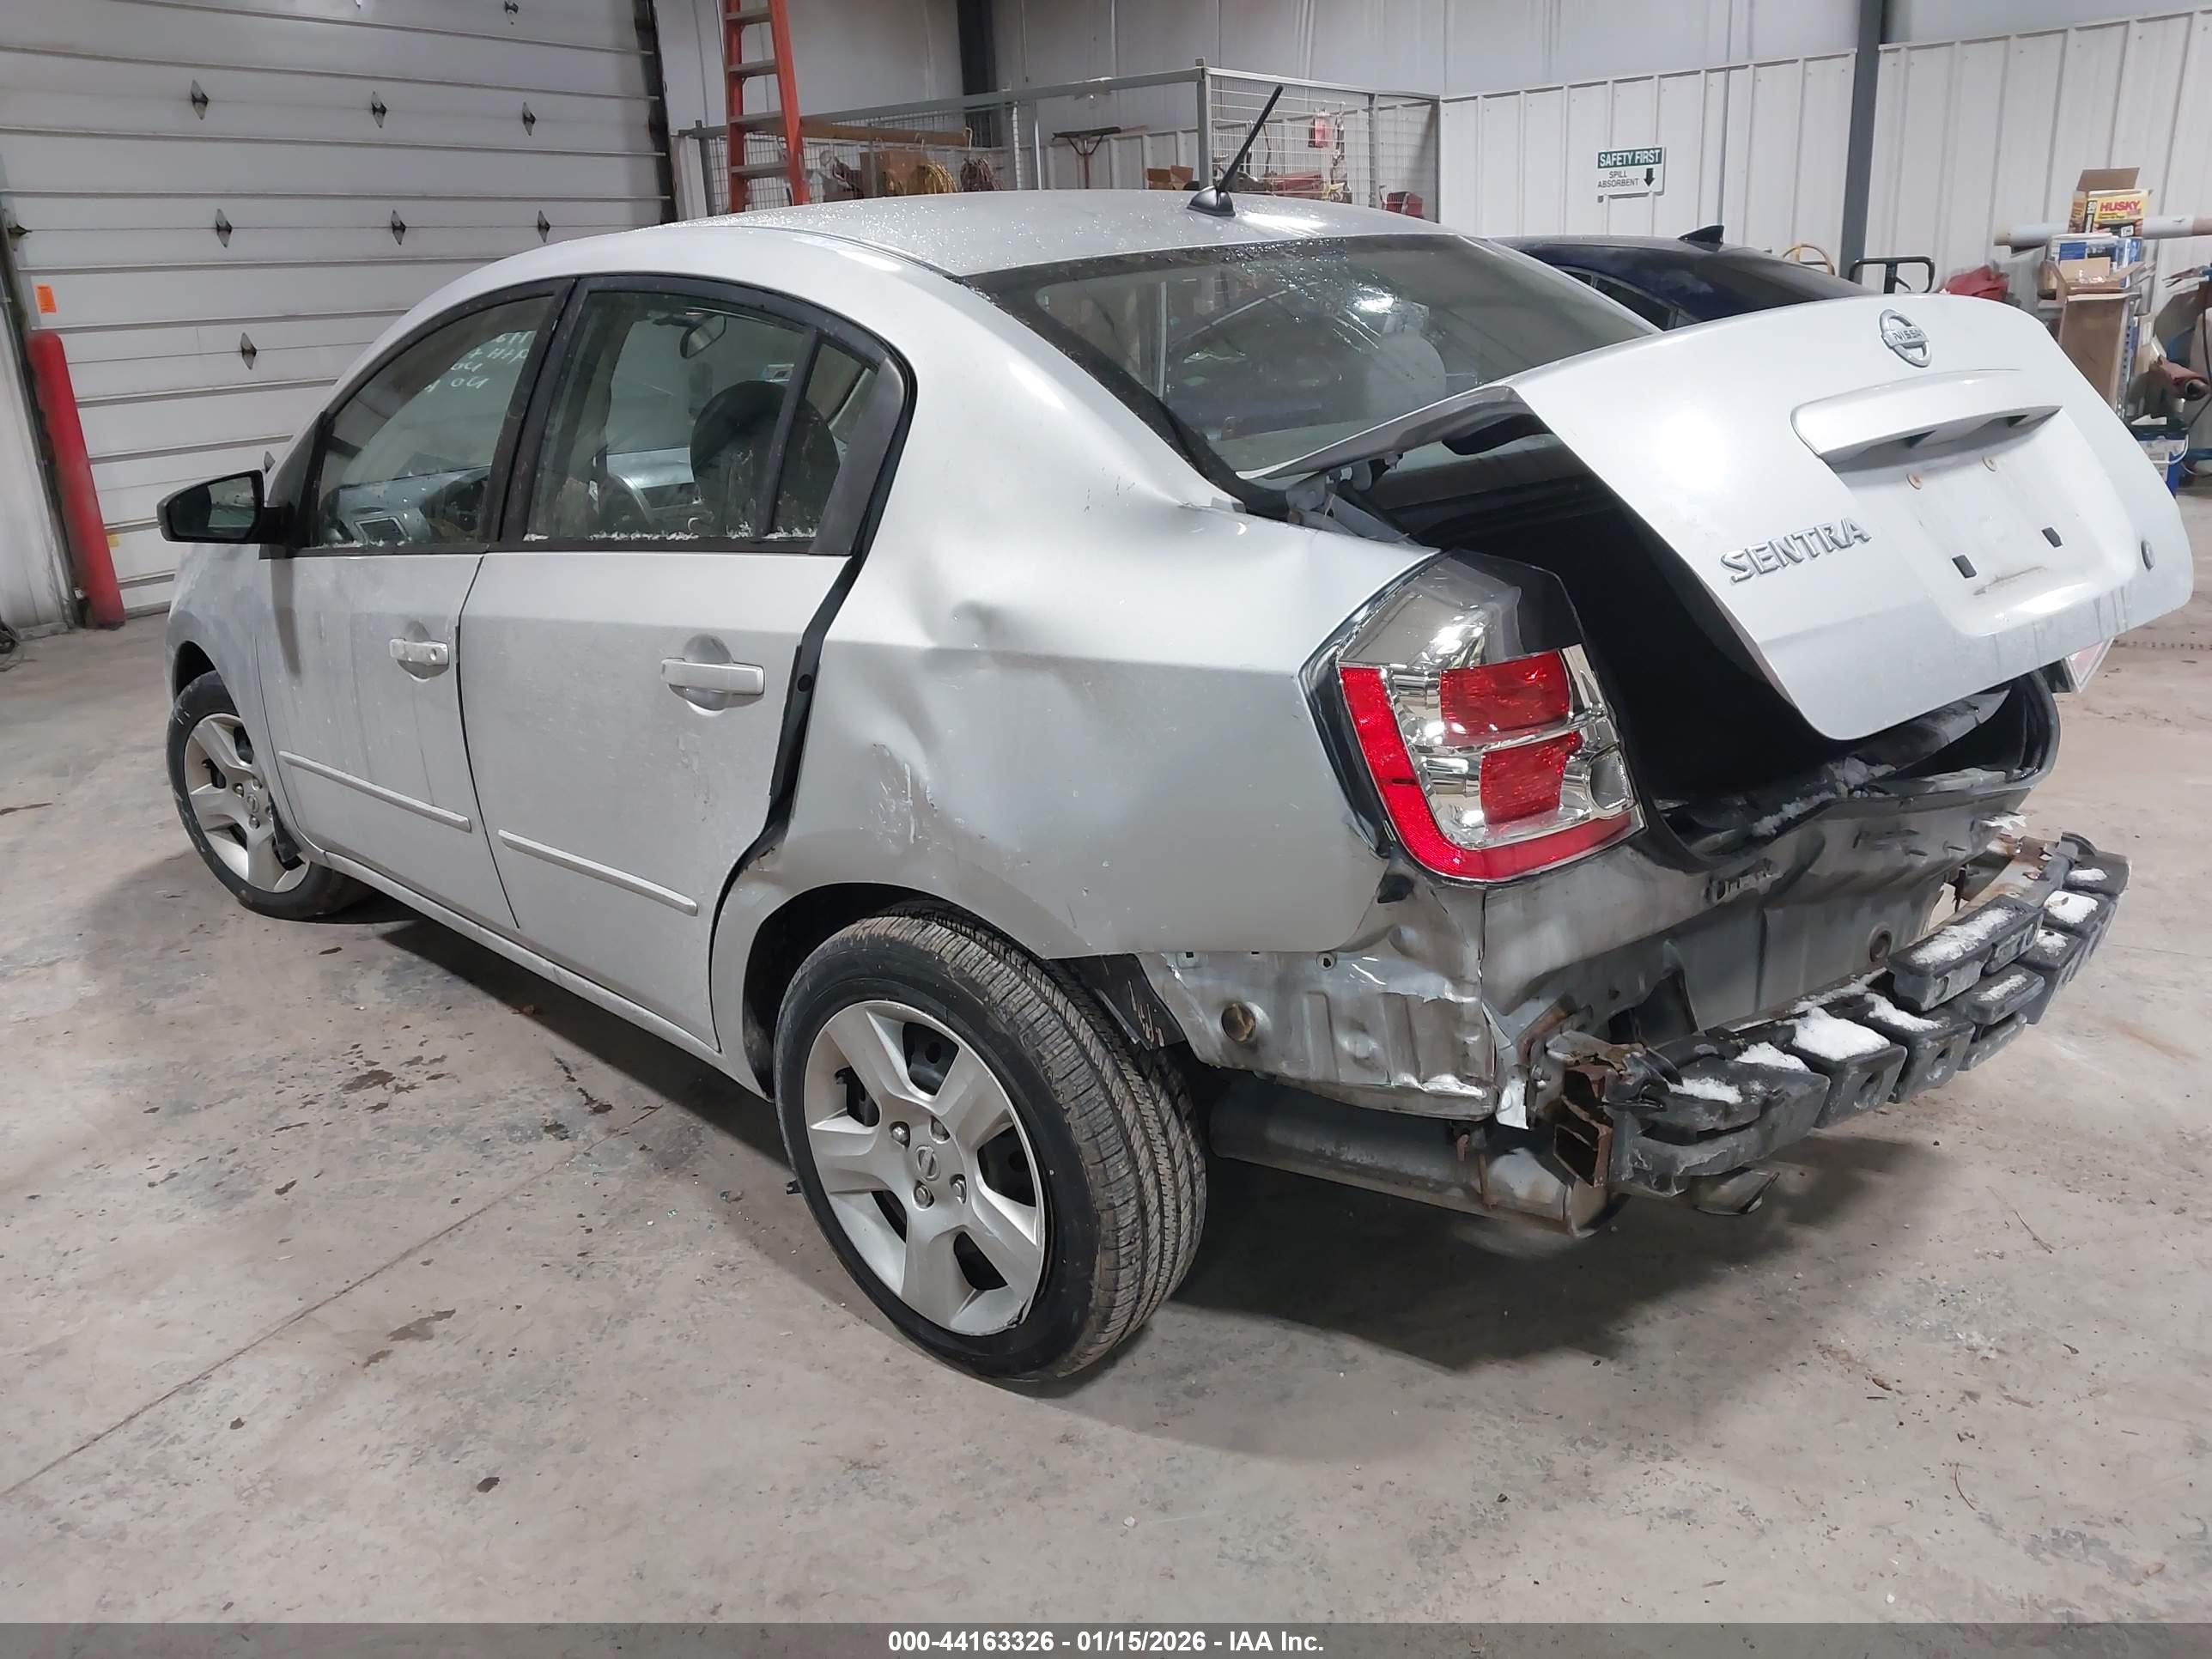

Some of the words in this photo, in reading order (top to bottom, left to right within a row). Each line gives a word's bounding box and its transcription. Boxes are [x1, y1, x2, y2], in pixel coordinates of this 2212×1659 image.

[1600, 152, 1633, 167] SAFETY
[1635, 149, 1661, 164] FIRST
[1598, 178, 1639, 188] ABSORBENT
[2100, 200, 2140, 212] HUSKY
[1720, 517, 1872, 584] SENTRA
